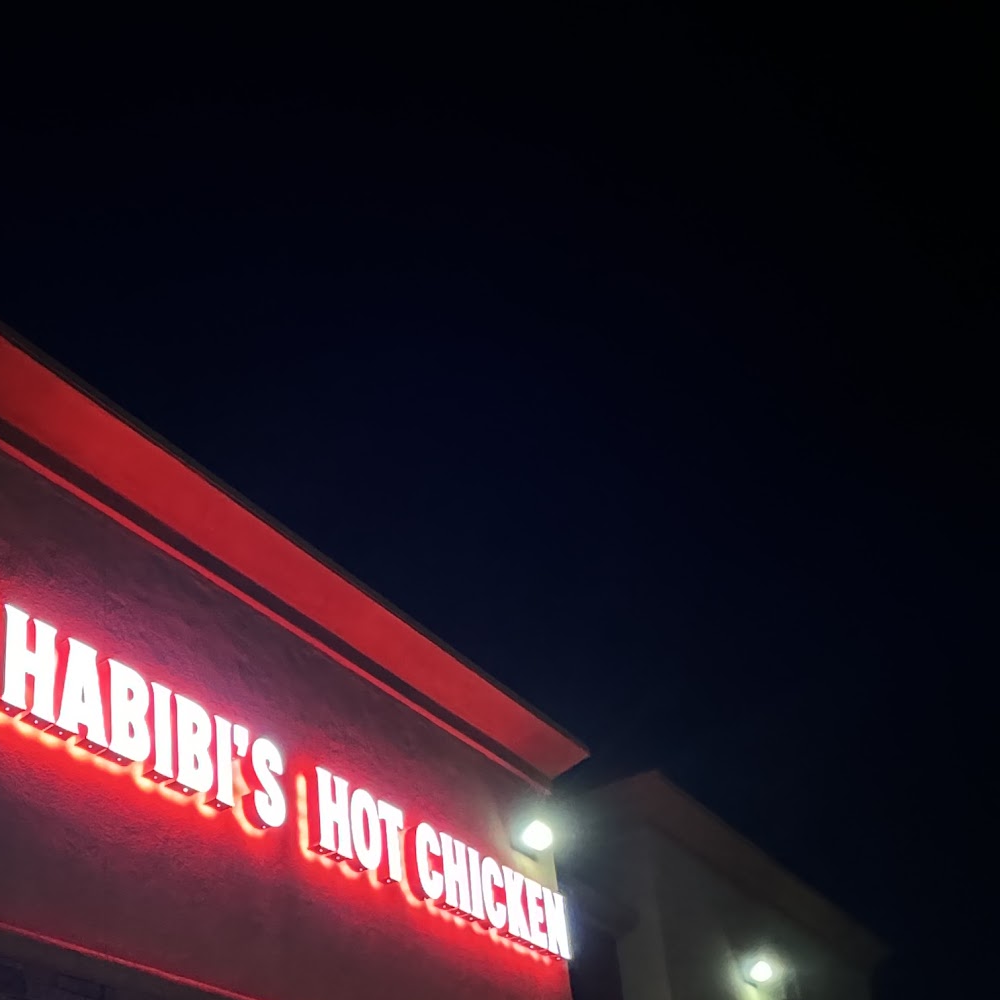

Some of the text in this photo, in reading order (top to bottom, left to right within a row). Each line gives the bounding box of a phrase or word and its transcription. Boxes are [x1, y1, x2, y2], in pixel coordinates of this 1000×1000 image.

[1, 603, 572, 961] HABIBI'S HOT CHICKEN
